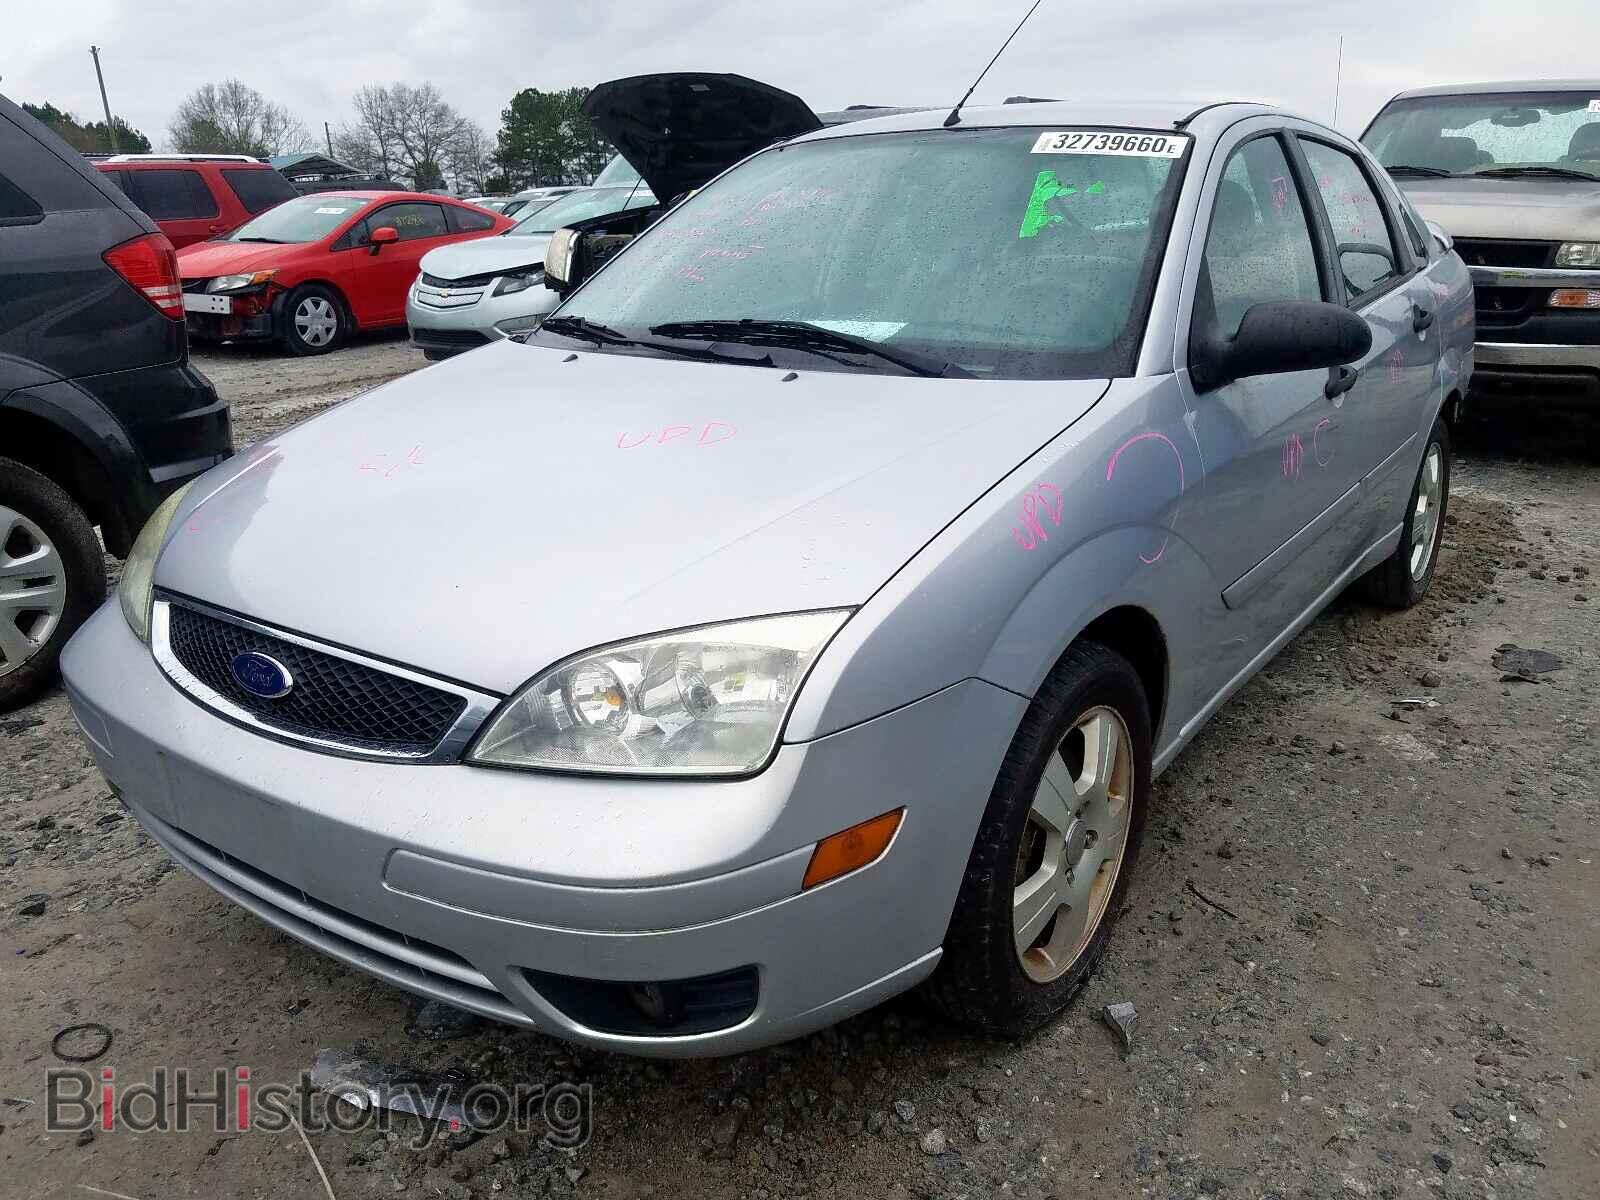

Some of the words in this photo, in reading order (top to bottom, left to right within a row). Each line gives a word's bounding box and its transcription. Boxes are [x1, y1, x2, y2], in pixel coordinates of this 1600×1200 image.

[1053, 133, 1167, 153] 32739660
[617, 421, 738, 449] UPD
[1012, 483, 1064, 550] UPD
